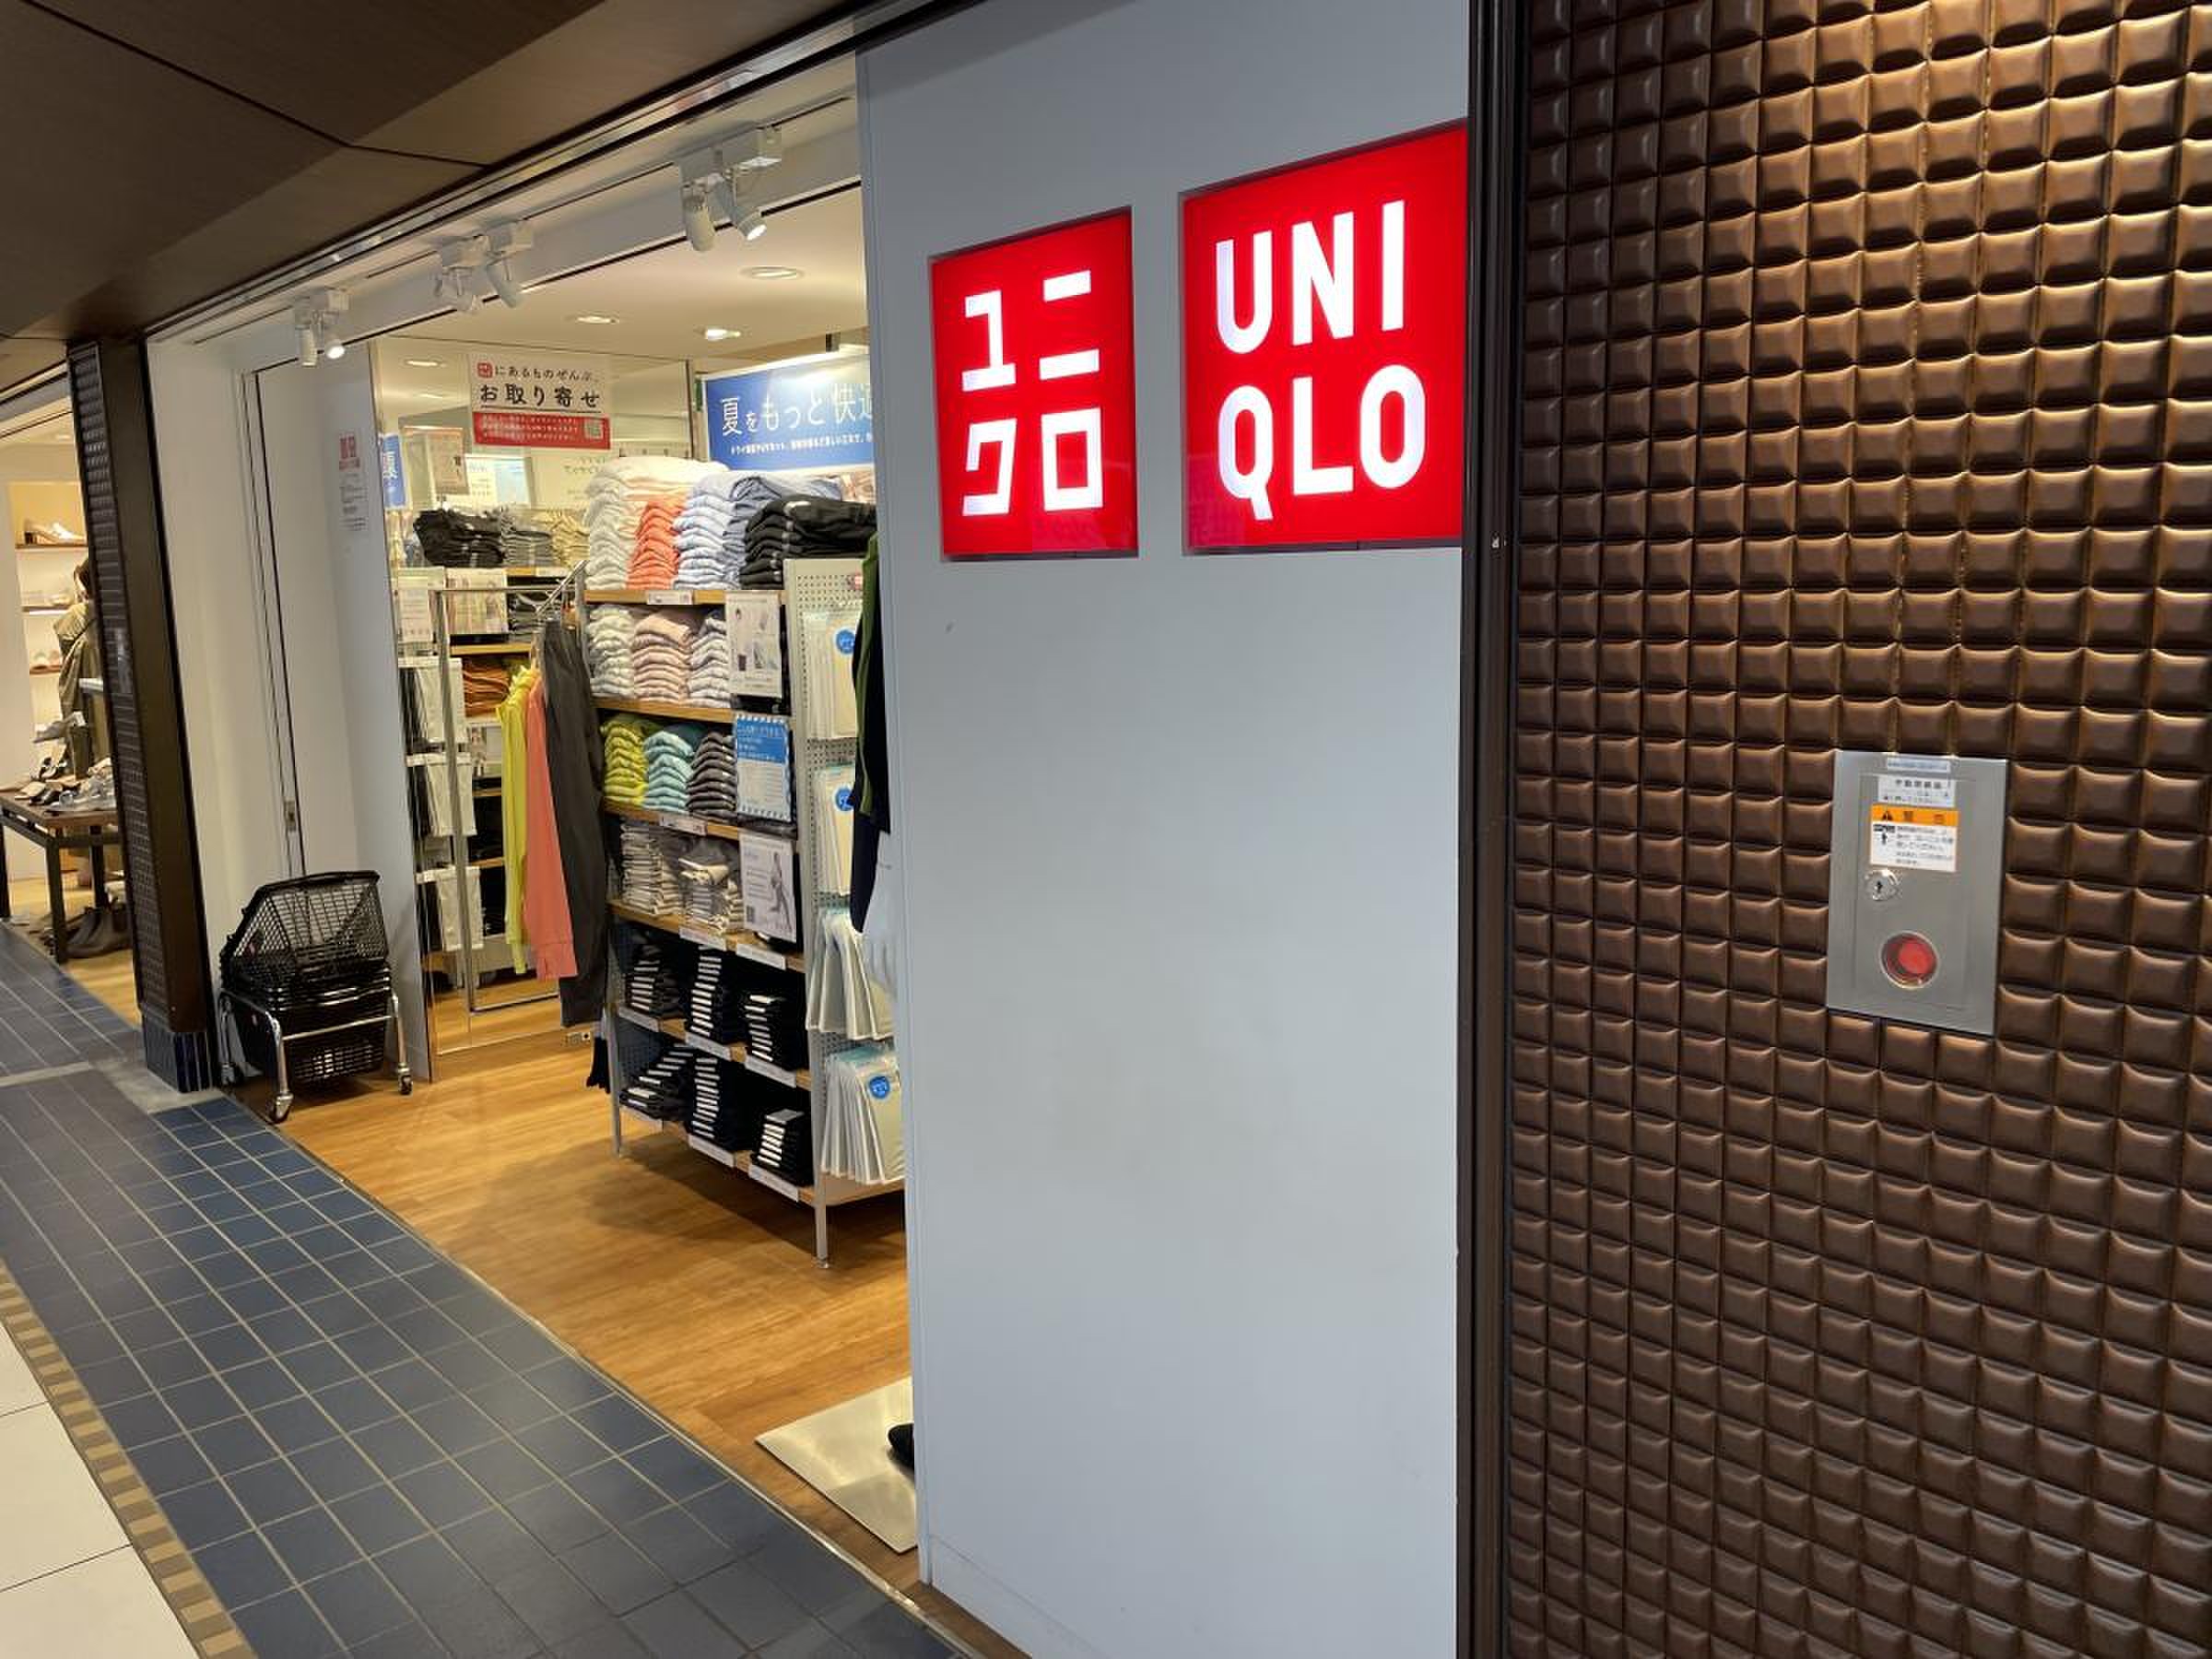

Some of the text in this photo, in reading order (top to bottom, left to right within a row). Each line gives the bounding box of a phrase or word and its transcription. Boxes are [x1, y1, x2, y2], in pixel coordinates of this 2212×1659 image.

[962, 270, 1100, 392] ユニ
[1216, 200, 1405, 354] UNI
[480, 383, 600, 407] お取り寄せ
[1218, 365, 1426, 521] QLO
[962, 407, 1103, 516] クロ
